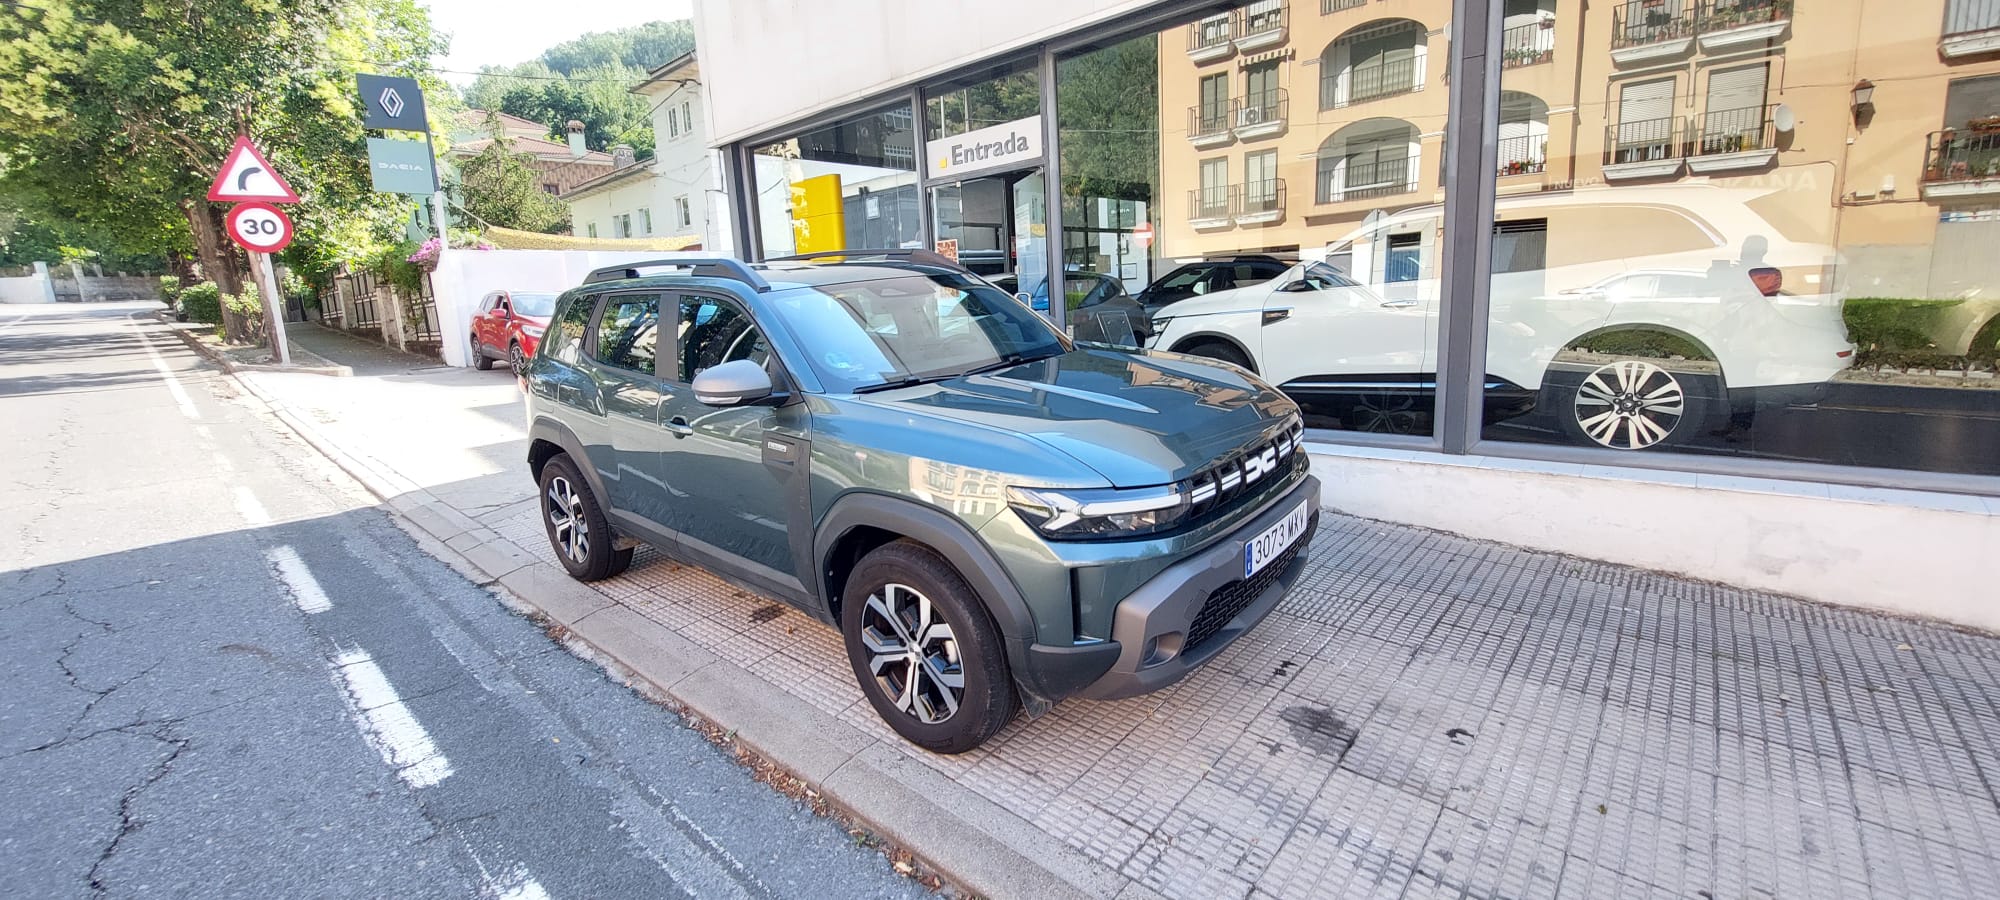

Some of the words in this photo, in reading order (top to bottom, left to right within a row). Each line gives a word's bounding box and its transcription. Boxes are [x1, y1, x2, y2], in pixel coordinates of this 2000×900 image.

[951, 131, 1030, 166] Entrada
[378, 162, 424, 171] DACIA
[243, 218, 277, 235] 30
[1256, 523, 1284, 564] 3073
